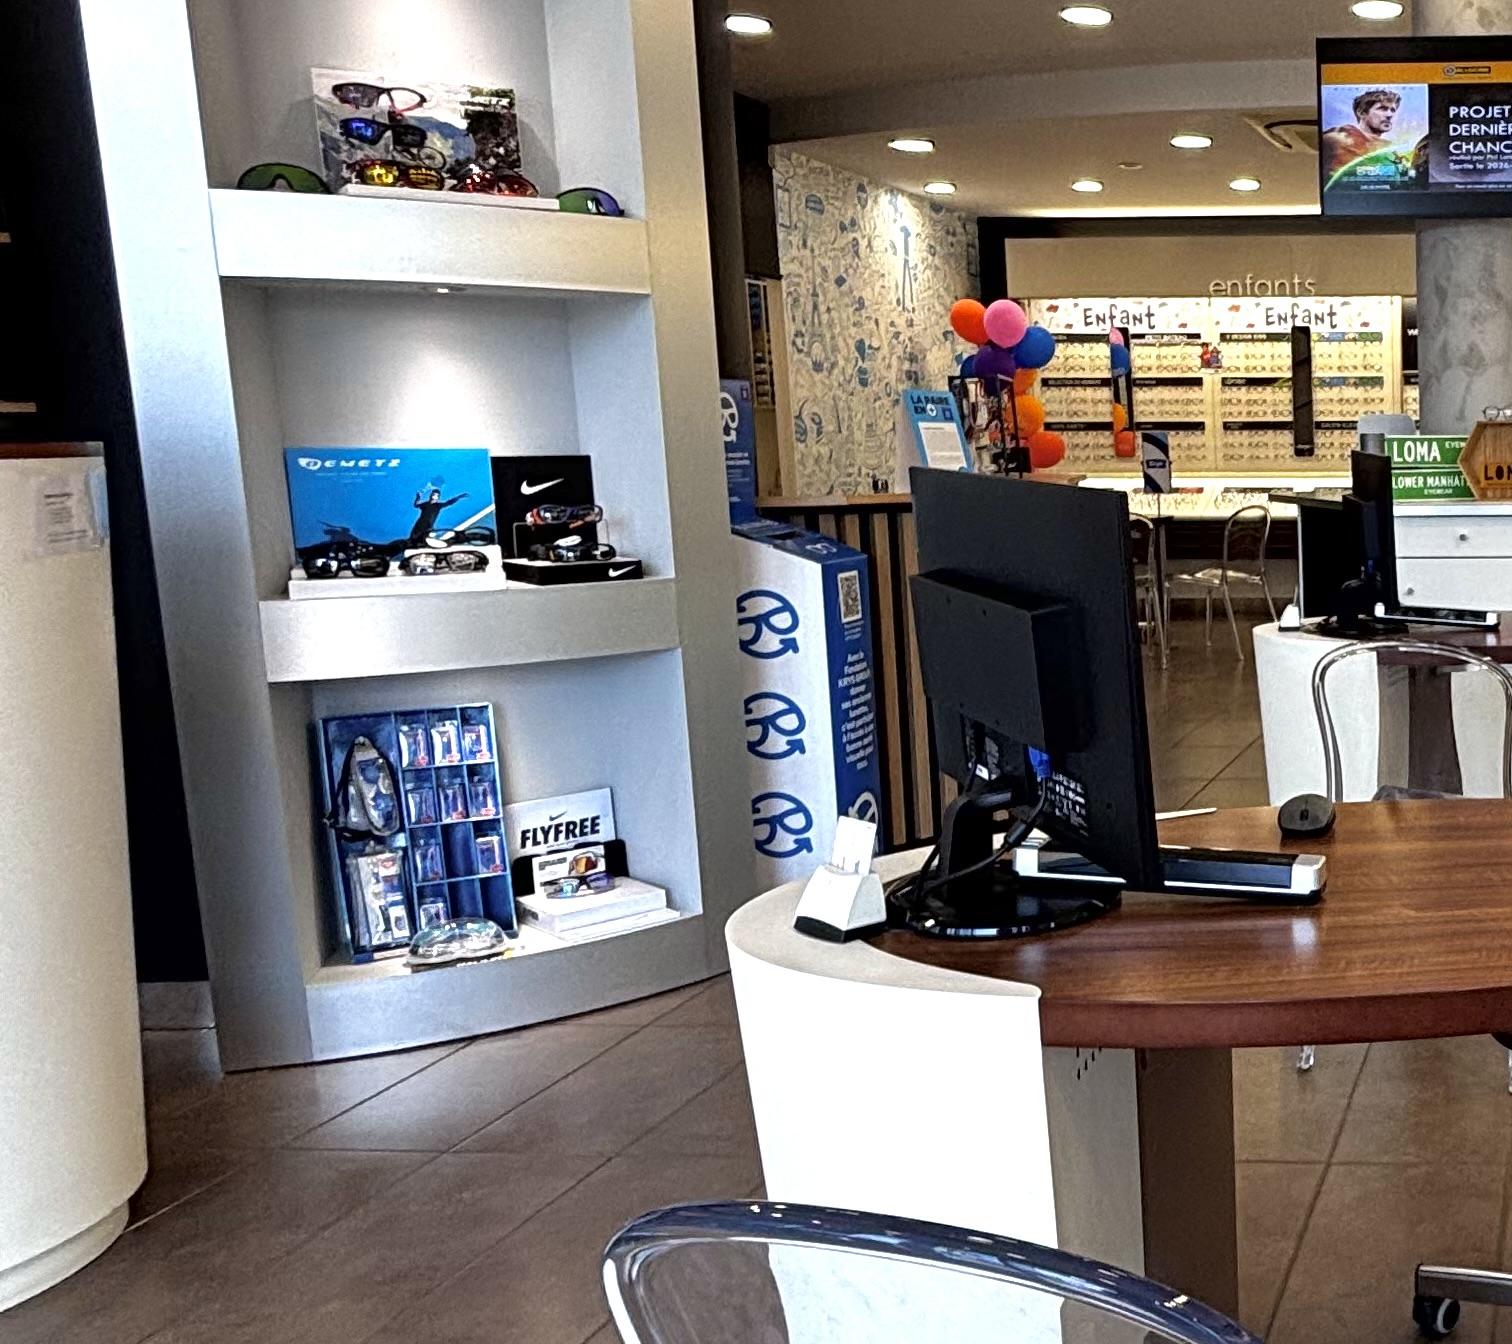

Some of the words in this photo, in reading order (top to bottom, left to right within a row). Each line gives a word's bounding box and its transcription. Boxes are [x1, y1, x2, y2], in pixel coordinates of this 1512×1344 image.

[1449, 105, 1512, 119] PROJET
[1209, 273, 1317, 296] enfants
[1393, 441, 1441, 463] LOMA
[1392, 475, 1424, 490] LOWER
[1426, 475, 1469, 488] MANHAT
[520, 815, 601, 850] FLYFREE
